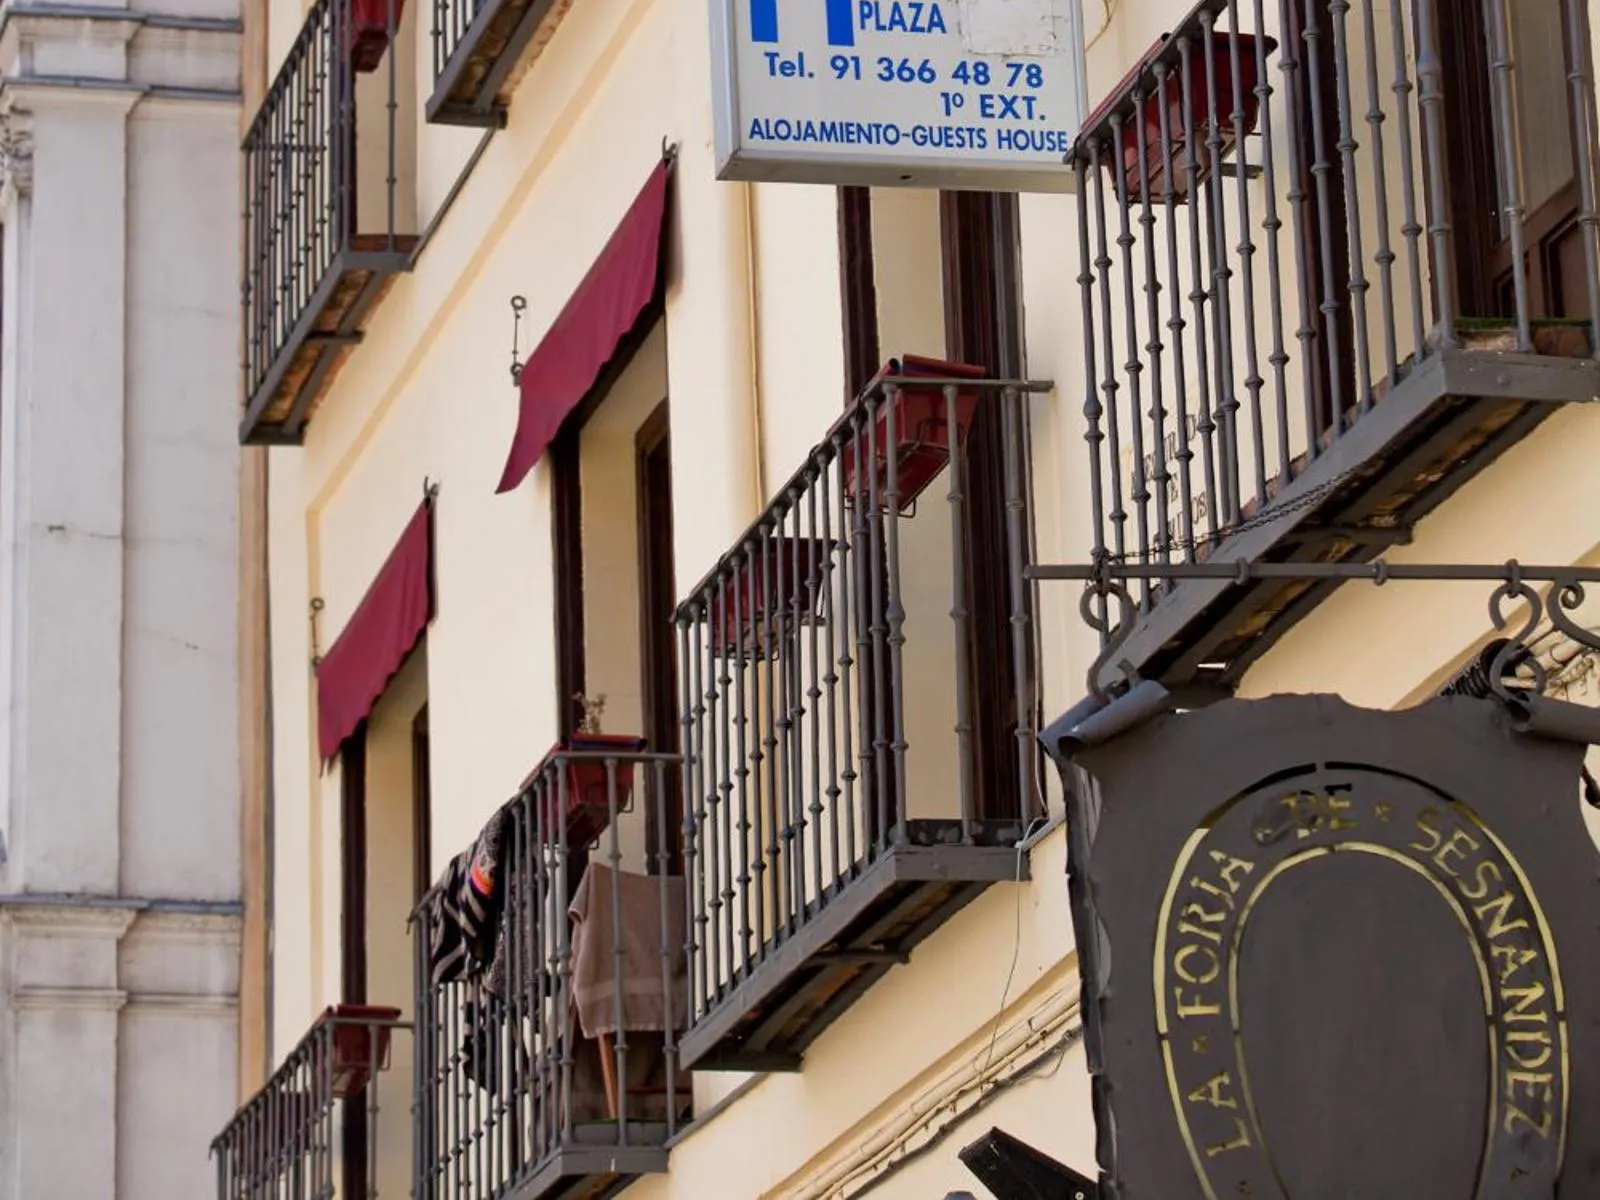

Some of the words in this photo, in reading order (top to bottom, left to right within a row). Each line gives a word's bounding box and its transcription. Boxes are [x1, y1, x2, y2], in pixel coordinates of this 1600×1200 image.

[857, 0, 947, 34] PLAZA
[764, 51, 815, 79] Tel.
[829, 55, 862, 81] 91
[877, 57, 937, 84] 366
[951, 60, 991, 88] 48
[1006, 63, 1044, 89] 78
[980, 94, 1047, 121] EXT.
[997, 130, 1068, 153] HOUSE
[1173, 850, 1255, 1019] FORJA
[1188, 1071, 1251, 1157] LA
